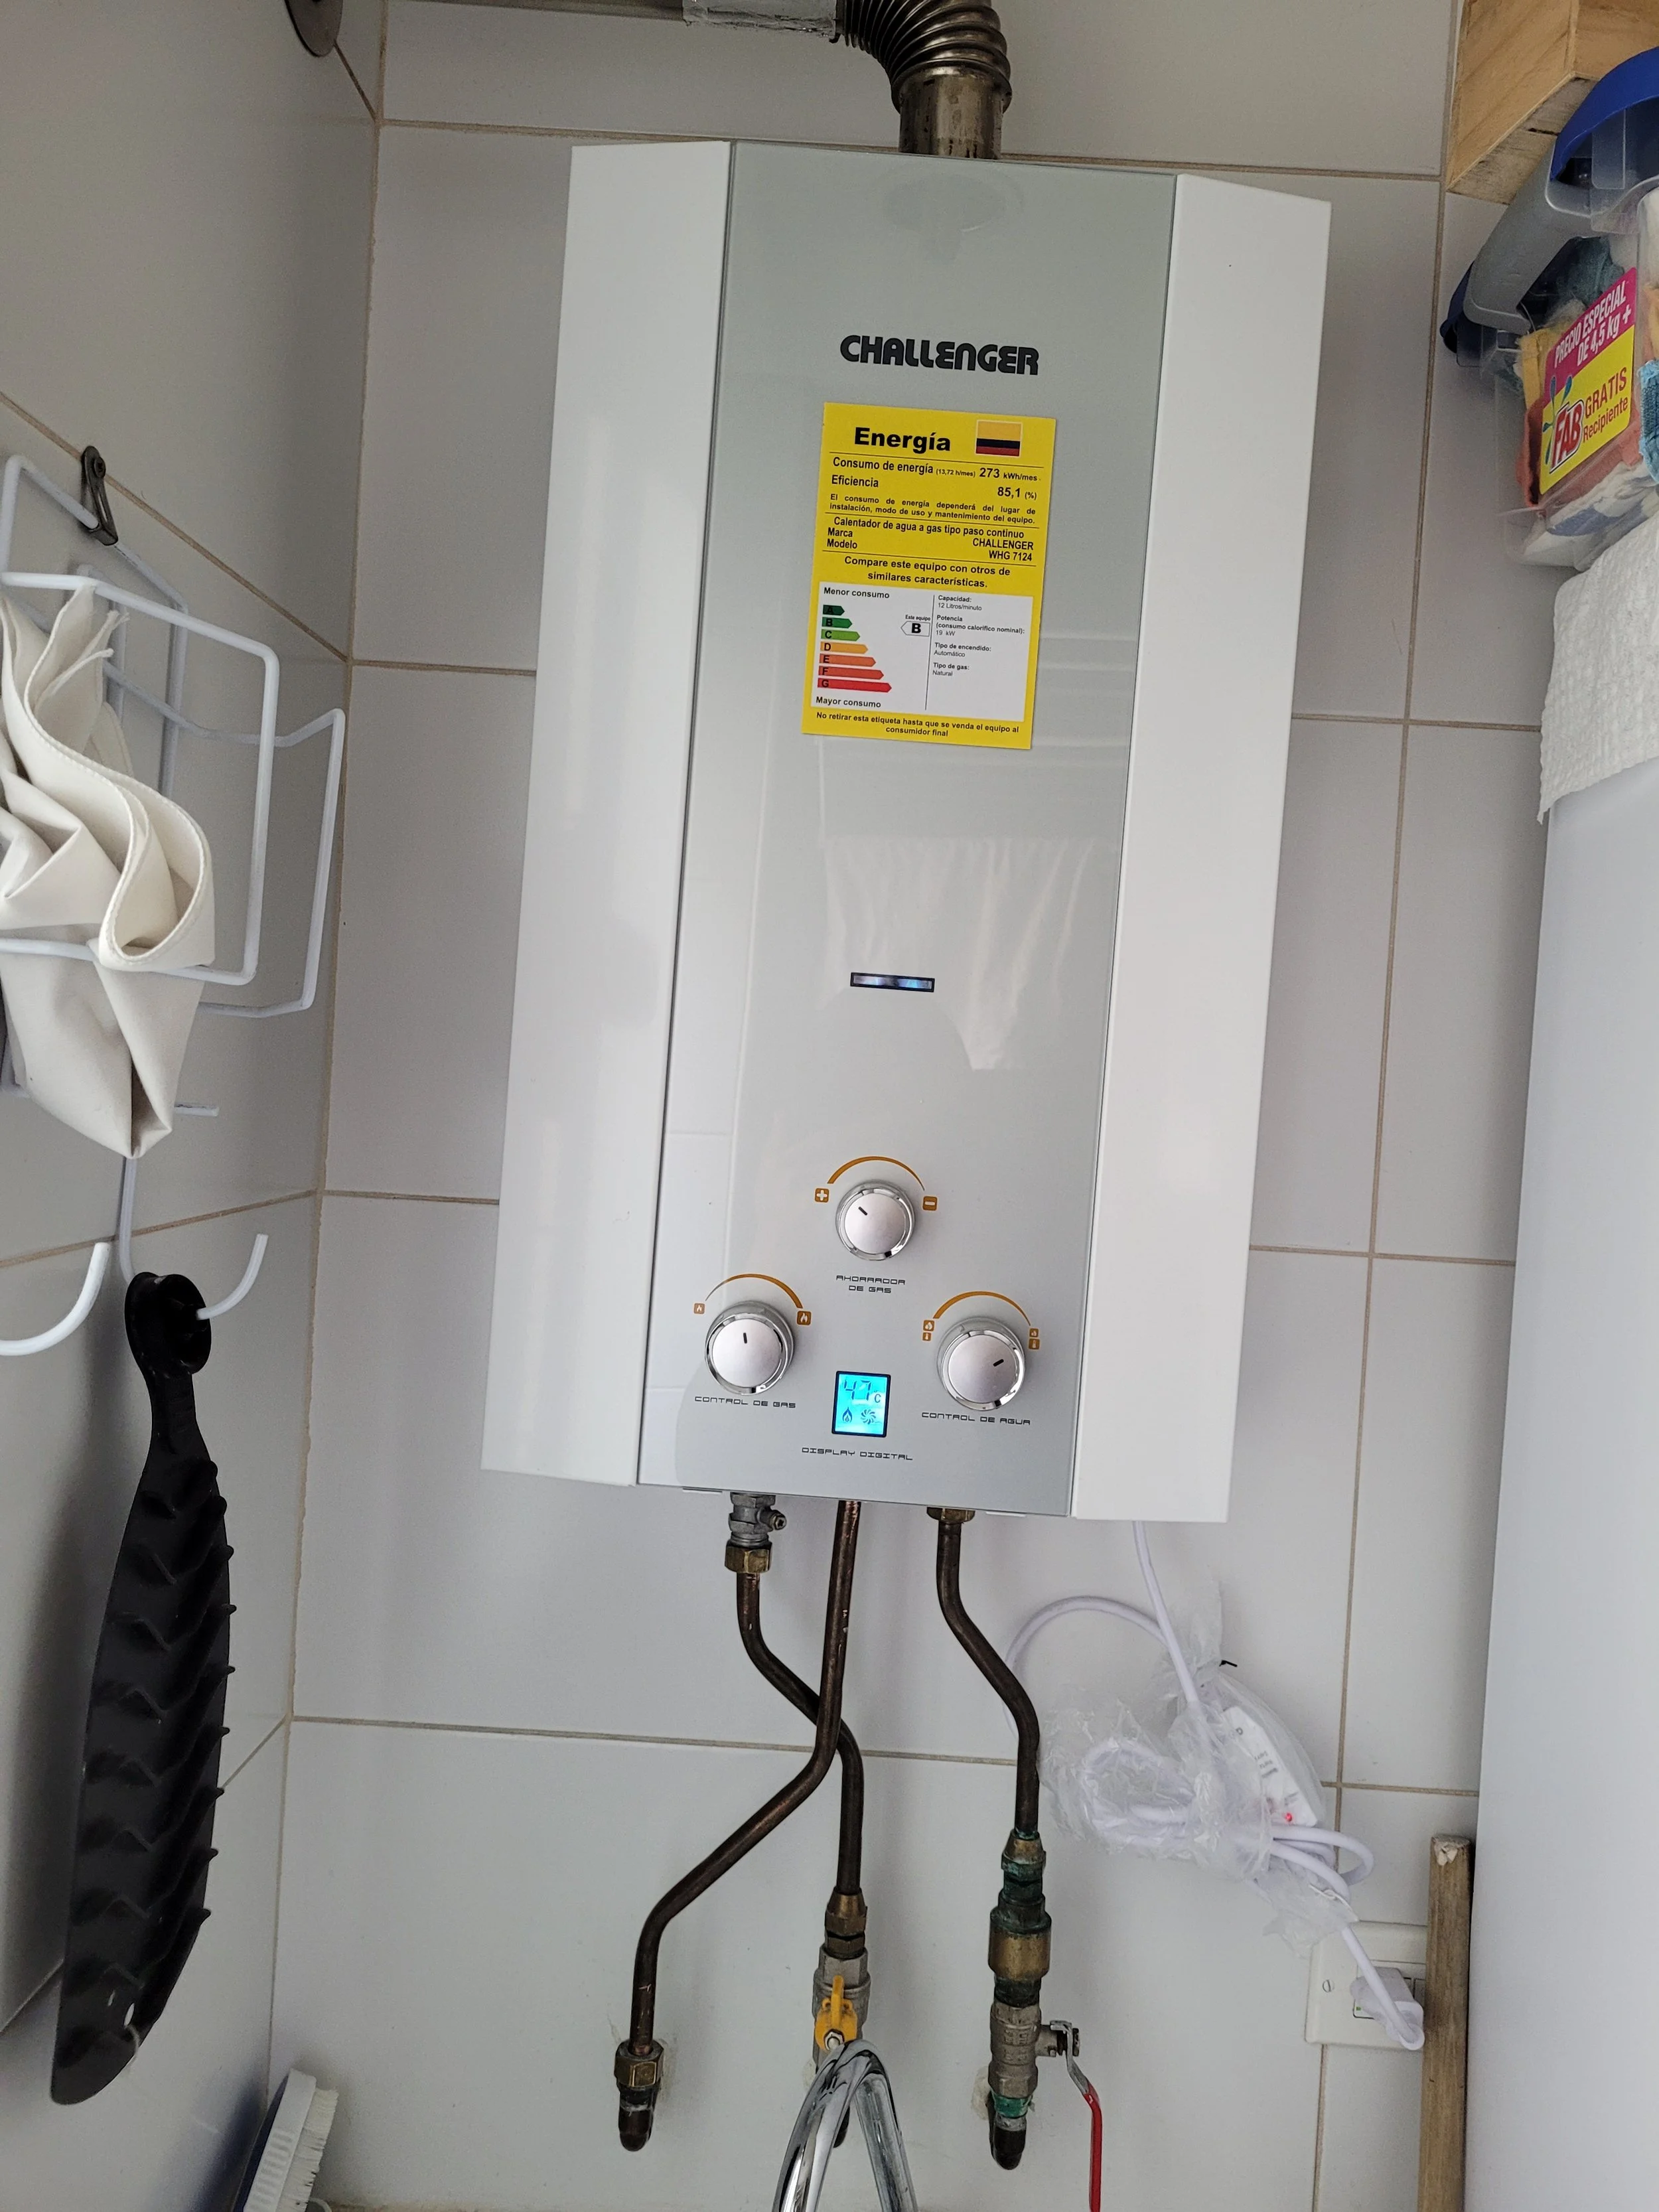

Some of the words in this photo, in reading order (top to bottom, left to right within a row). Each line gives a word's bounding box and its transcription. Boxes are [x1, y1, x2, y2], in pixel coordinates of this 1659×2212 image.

[1554, 321, 1582, 369] PRECIO
[1582, 280, 1626, 340] ESPECIAL
[1577, 338, 1588, 366] DE
[1590, 327, 1605, 354] 4,5
[1607, 313, 1621, 340] kg
[840, 334, 1039, 376] CHALLENGER
[1584, 367, 1627, 419] GRATIS
[1583, 397, 1628, 443] Recipiente
[854, 427, 951, 454] Energía
[1550, 404, 1583, 469] FAB
[833, 457, 880, 470] Consumo
[883, 461, 895, 471] de
[897, 463, 933, 475] energía
[979, 467, 1000, 479] 273
[1003, 473, 1037, 481] kWh/mes
[831, 475, 879, 488] Eficiencia
[997, 486, 1021, 498] 85,1
[1025, 492, 1037, 500] (%)
[830, 503, 873, 513] instalación,
[935, 512, 990, 520] mantenimiento
[902, 500, 930, 508] energía
[936, 502, 975, 510] dependerá
[1001, 506, 1020, 514] lugar
[828, 527, 853, 537] Marca
[834, 516, 881, 528] Calentador
[896, 522, 916, 532] agua
[926, 525, 942, 534] gas
[944, 525, 960, 536] tipo
[963, 528, 984, 536] paso
[986, 529, 1024, 538] continuo
[827, 538, 857, 549] Modelo
[972, 538, 1034, 550] CHALLENGER
[989, 550, 1010, 559] WHG
[1013, 552, 1033, 561] 7124
[845, 556, 888, 567] Compare
[891, 560, 911, 569] este
[914, 562, 947, 573] equipo
[970, 566, 995, 575] otros
[867, 571, 911, 583] similares
[914, 575, 987, 588] características.
[851, 590, 890, 599] consumo
[825, 630, 832, 639] C
[911, 623, 921, 634] B
[824, 642, 831, 651] D
[822, 679, 829, 688] G
[816, 697, 840, 706] Mayor
[843, 699, 881, 708] consumo
[829, 712, 851, 721] retirar
[871, 715, 901, 725] etiqueta
[886, 726, 930, 736] consumidor
[836, 1275, 905, 1285] AHORRADOR
[843, 1380, 871, 1401] 47
[695, 1396, 749, 1405] CONTROL
[922, 1412, 975, 1421] CONTROL
[802, 1447, 855, 1456] DISPLAY
[859, 1451, 913, 1460] DIGITAL
